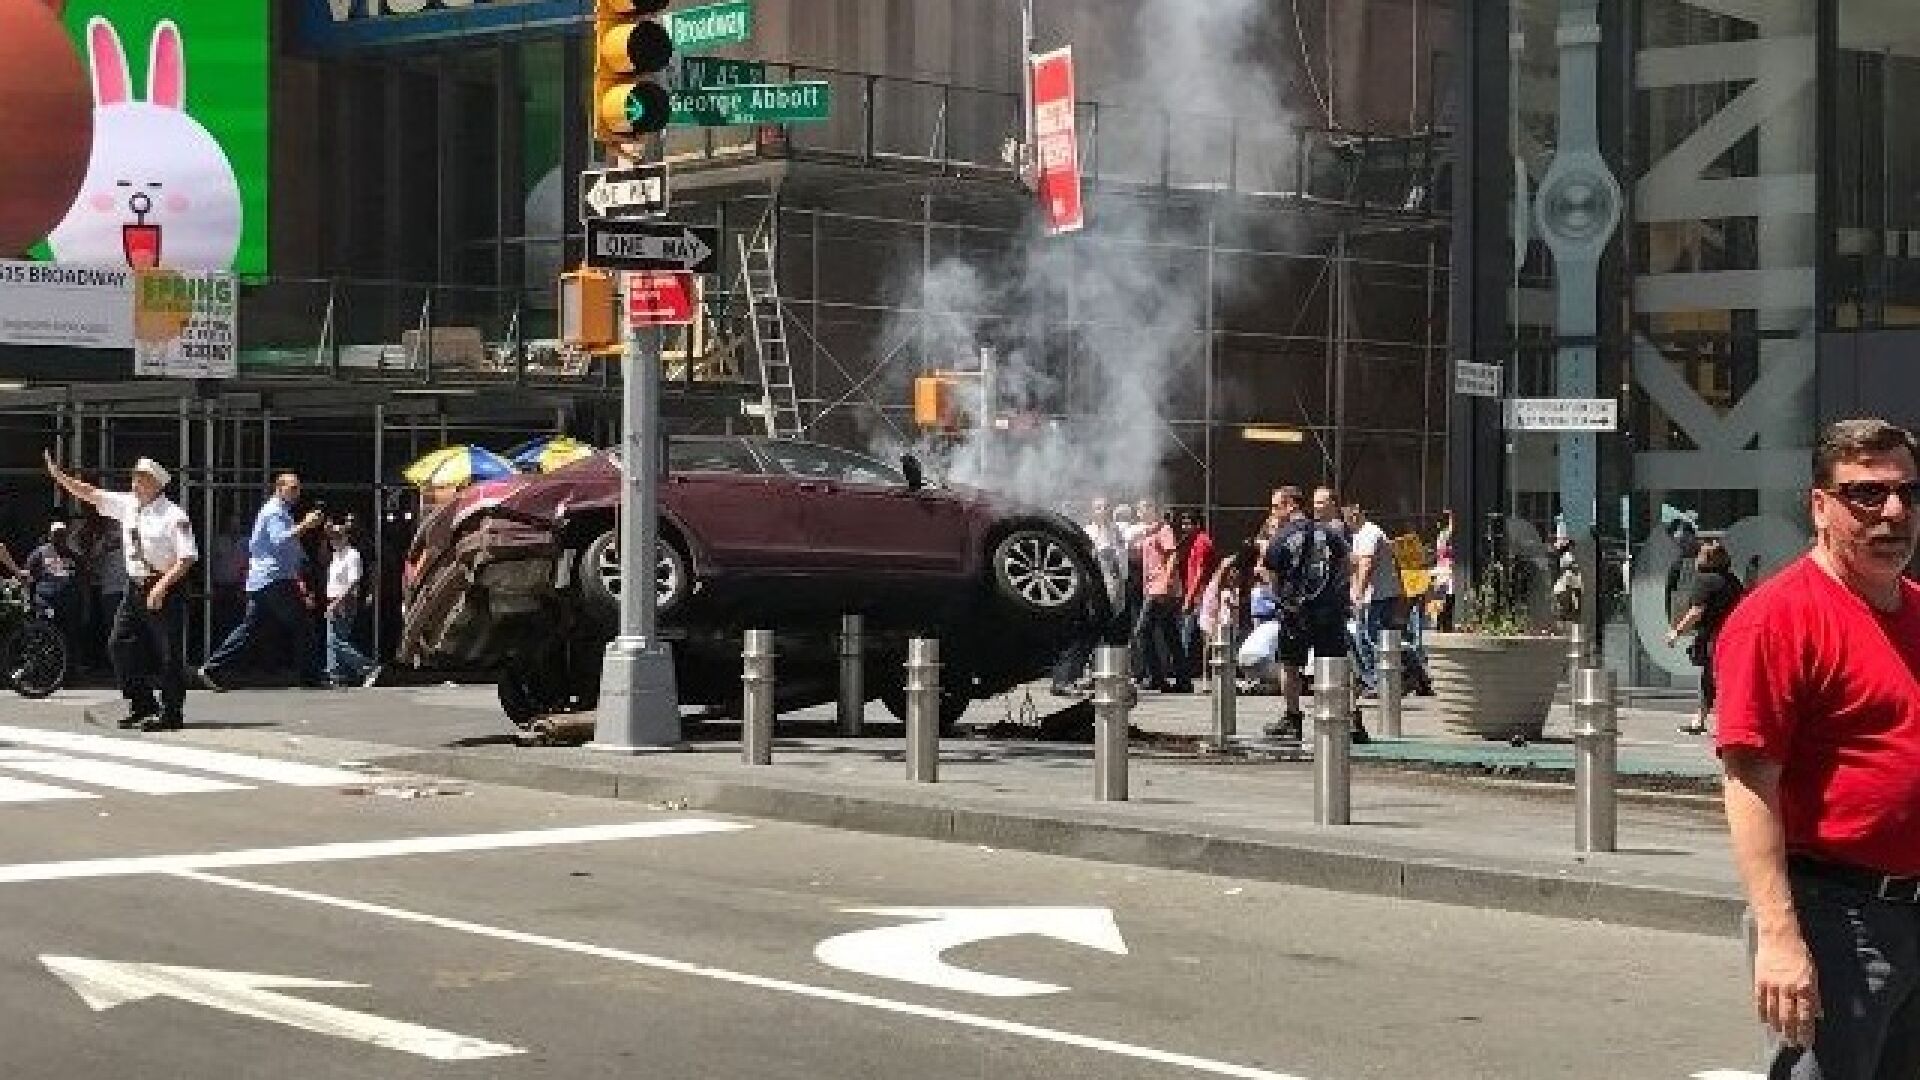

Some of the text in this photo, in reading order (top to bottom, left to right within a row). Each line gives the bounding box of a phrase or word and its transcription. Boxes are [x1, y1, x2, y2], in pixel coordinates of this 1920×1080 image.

[674, 12, 745, 45] Broadway
[668, 86, 818, 117] George Abbott
[605, 235, 700, 259] ONE WAY
[0, 267, 126, 286] 15 BROADWAY
[1633, 0, 1817, 676] SKIN
